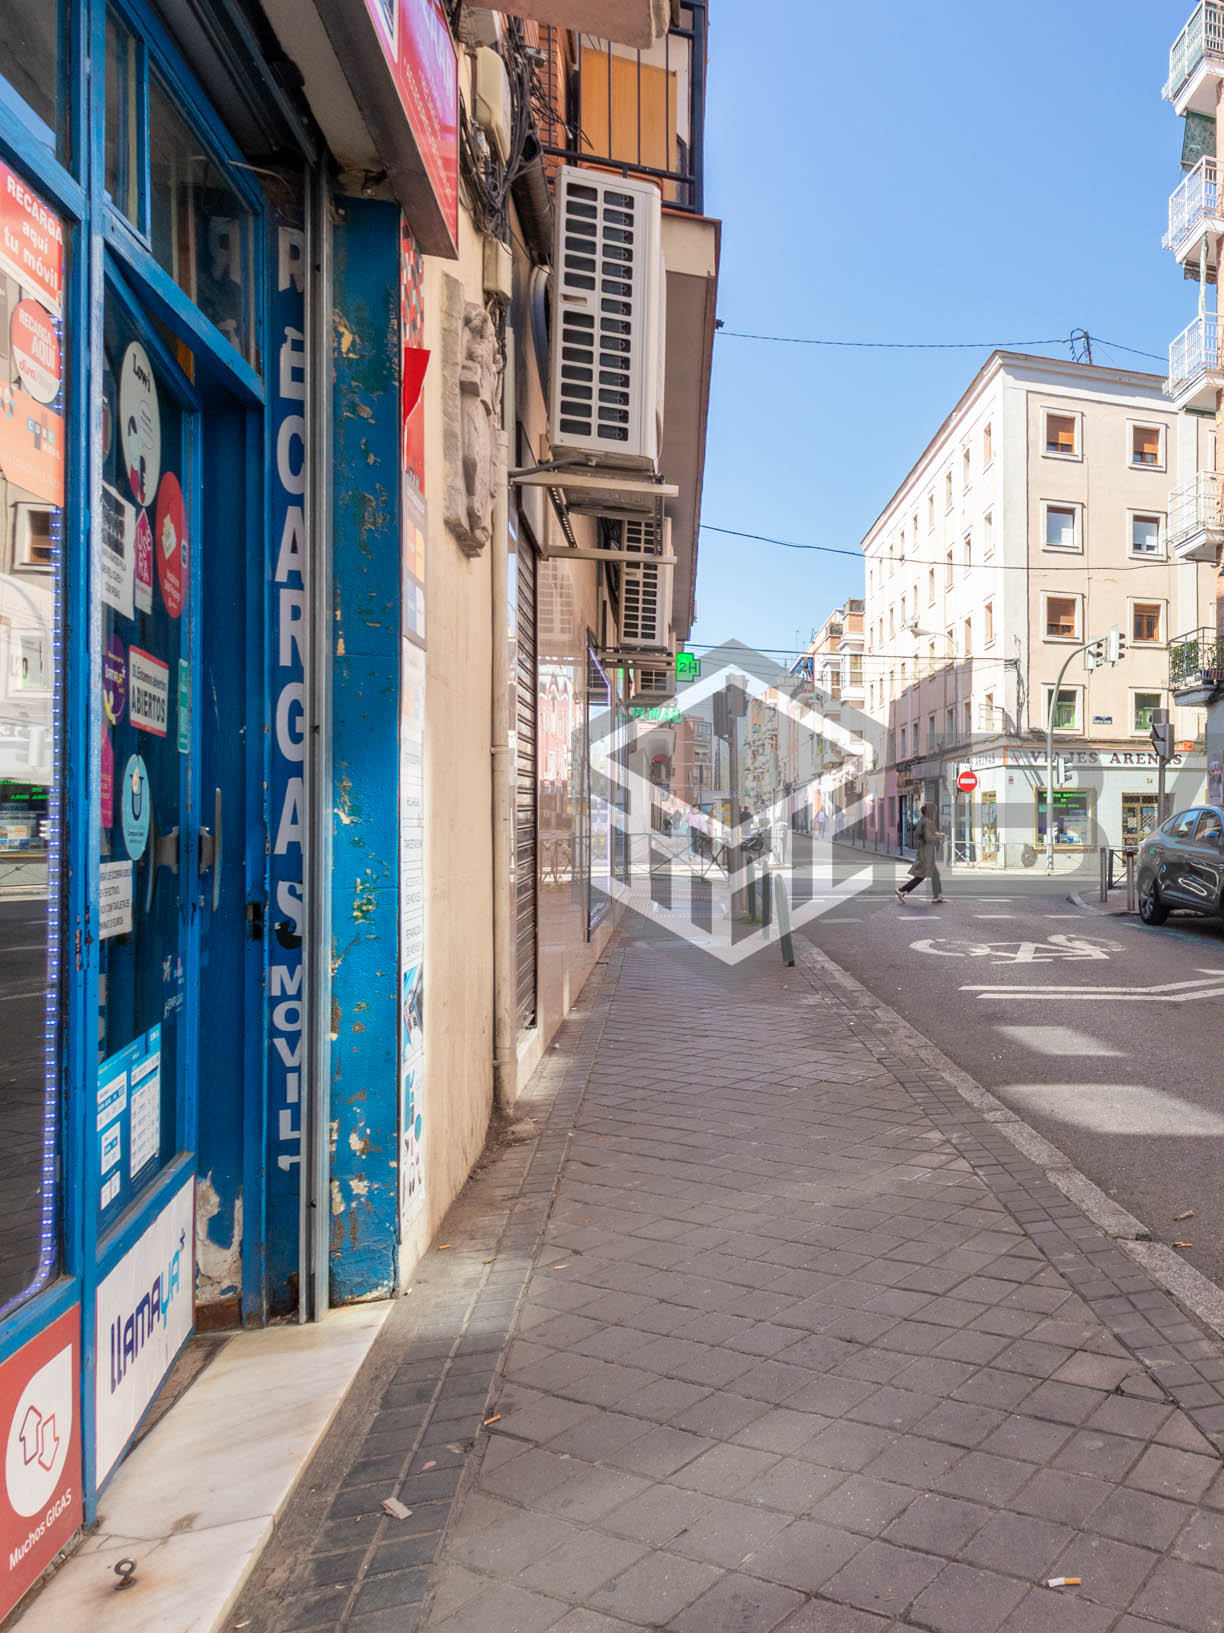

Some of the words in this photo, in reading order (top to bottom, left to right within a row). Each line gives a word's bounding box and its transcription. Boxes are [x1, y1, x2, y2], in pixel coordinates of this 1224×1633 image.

[6, 174, 63, 246] RECARGA
[4, 225, 19, 256] tu
[23, 246, 59, 291] móvil
[131, 685, 166, 723] ABIERTOS
[1110, 752, 1183, 765] ARENS
[9, 1523, 46, 1570] Muchos
[45, 1488, 73, 1528] GIGAS
